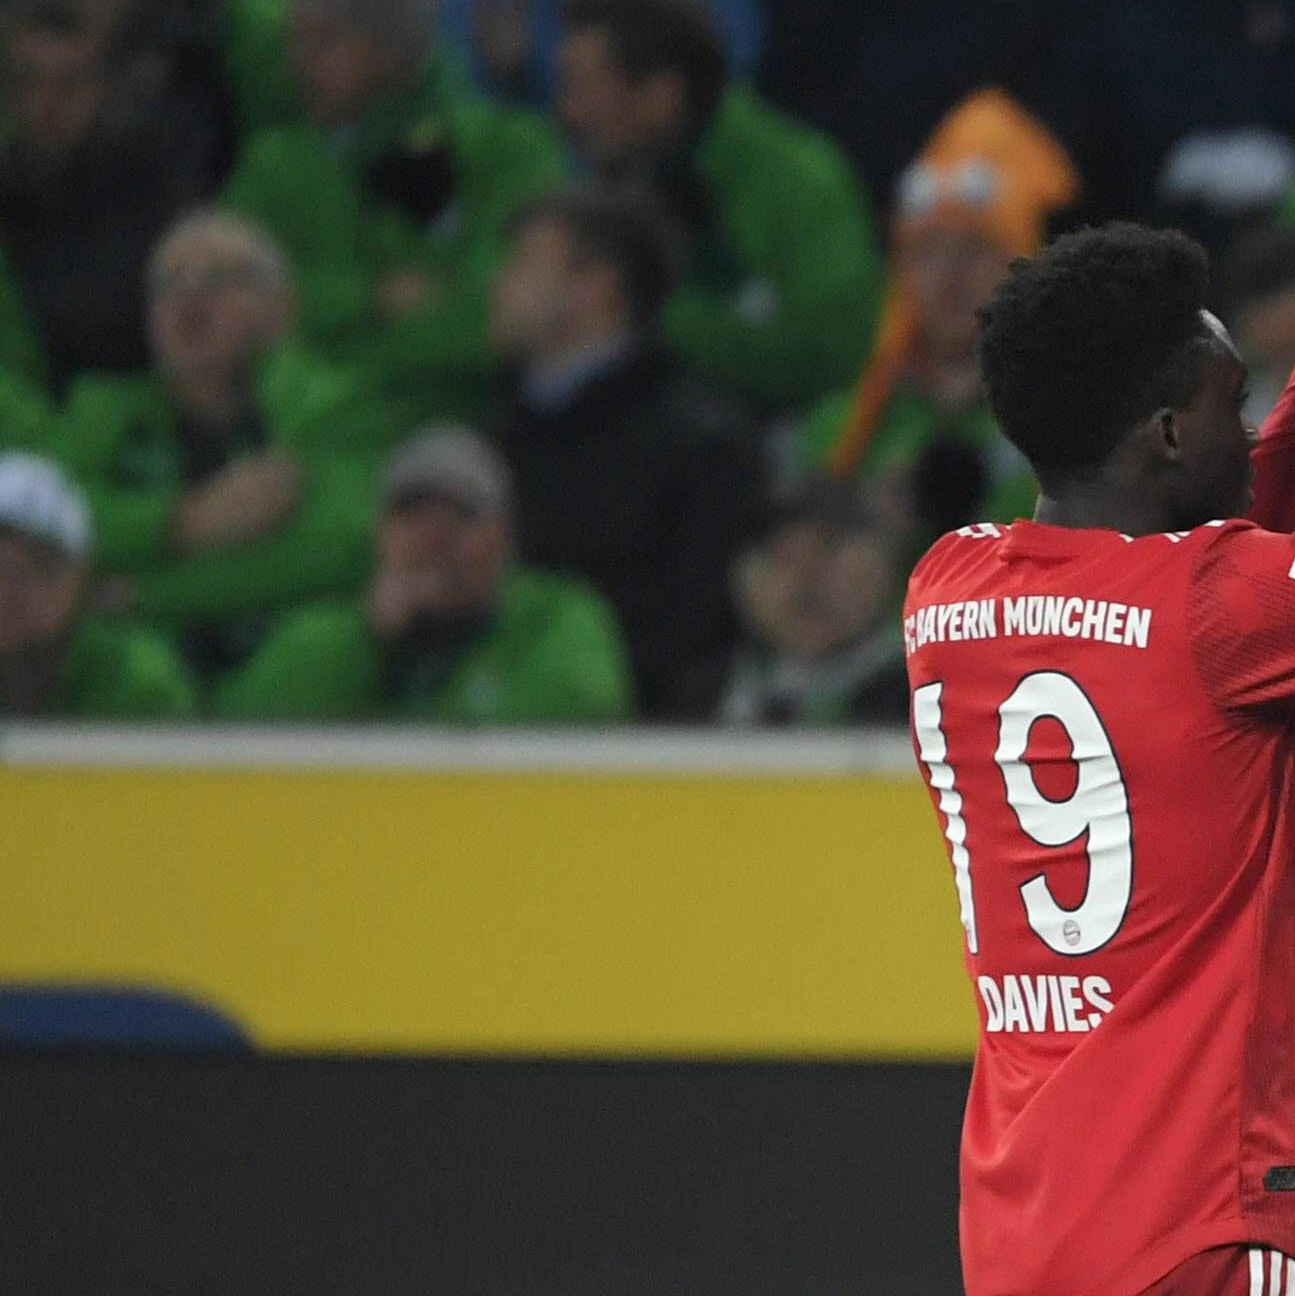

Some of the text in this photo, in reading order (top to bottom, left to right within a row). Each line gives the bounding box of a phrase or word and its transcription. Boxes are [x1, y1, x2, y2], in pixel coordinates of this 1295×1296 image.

[917, 598, 997, 648] BAYERN
[1002, 595, 1153, 649] MÜNCHEN
[914, 670, 1134, 957] 19
[977, 974, 1115, 1033] DAVIES
